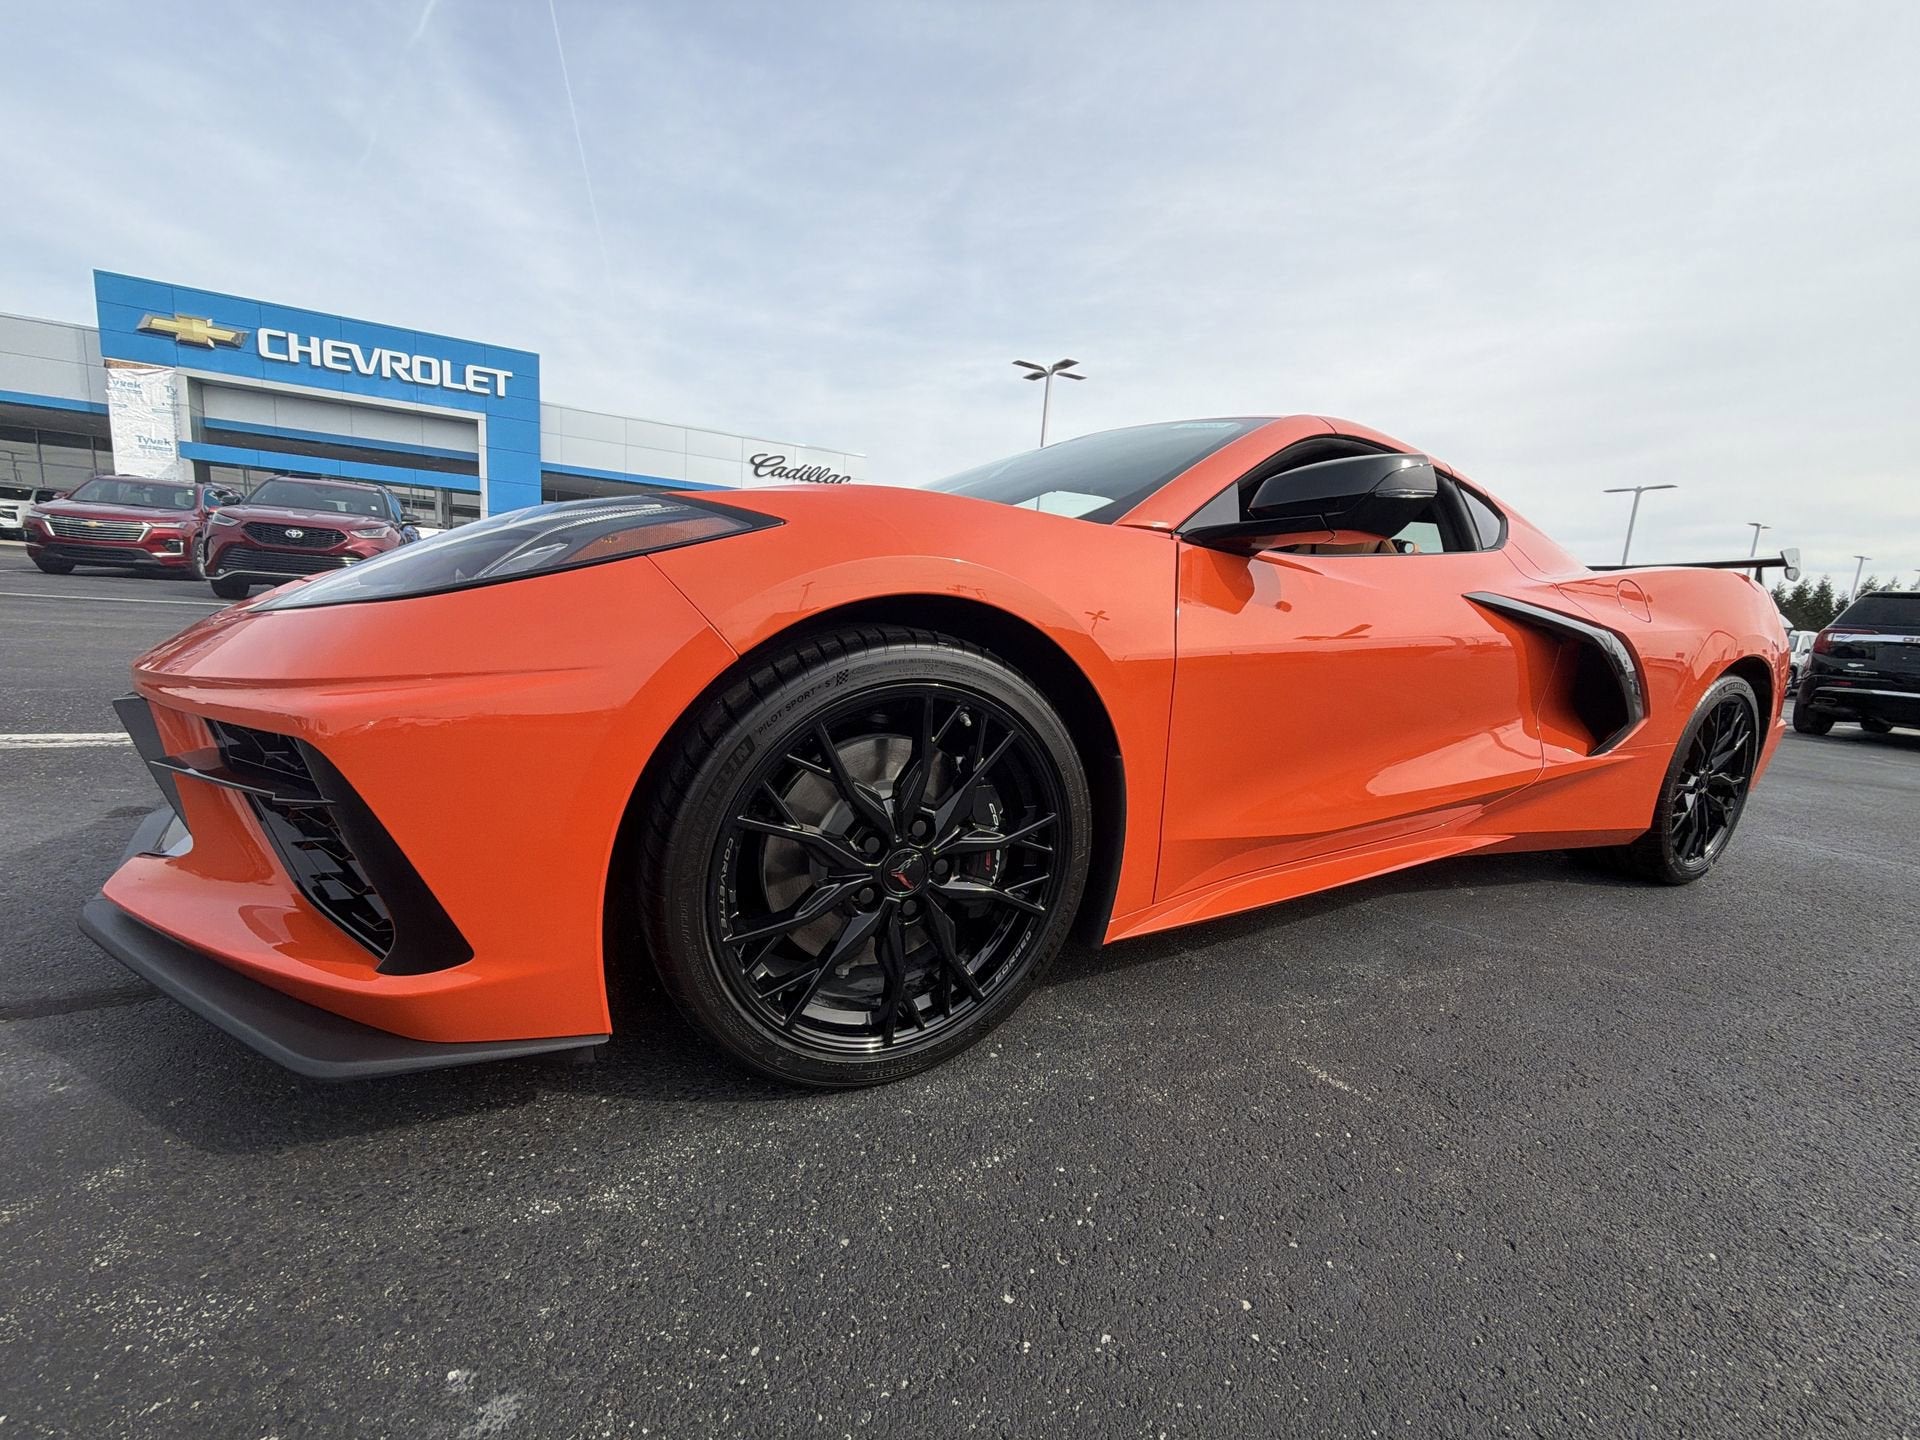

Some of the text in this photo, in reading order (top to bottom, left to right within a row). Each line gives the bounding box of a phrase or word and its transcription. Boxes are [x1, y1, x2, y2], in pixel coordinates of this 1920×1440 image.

[257, 327, 513, 397] CHEVROLET
[136, 435, 173, 447] Tyvek
[750, 453, 852, 484] Cadillac
[758, 709, 783, 735] PILOT
[785, 687, 817, 712] SPORT
[719, 837, 734, 929] CORVETTE
[995, 930, 1032, 983] FORGED
